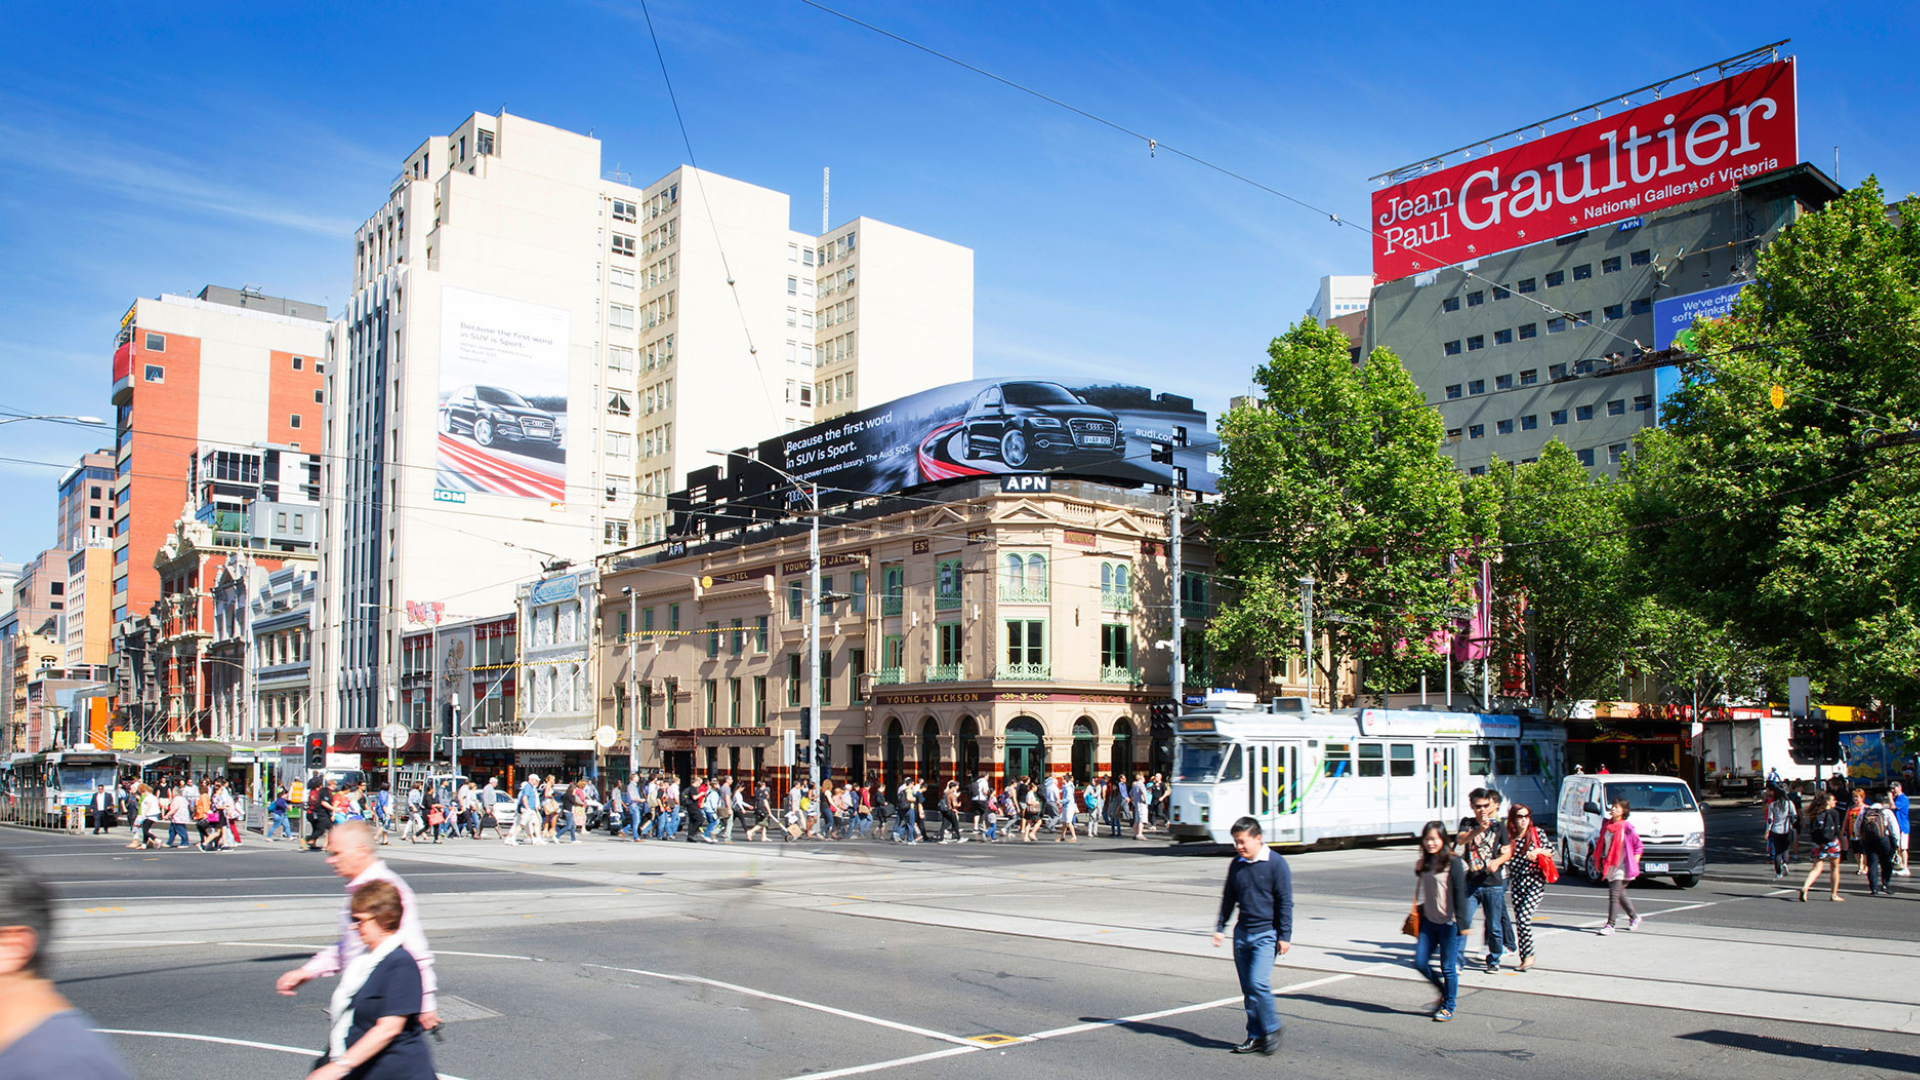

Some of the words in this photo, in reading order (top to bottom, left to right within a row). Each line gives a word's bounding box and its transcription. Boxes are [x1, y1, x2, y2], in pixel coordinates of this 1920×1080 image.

[1457, 97, 1777, 231] Gaultier
[1584, 195, 1641, 221] National
[1644, 180, 1696, 206] Gallery
[1698, 171, 1716, 189] of
[1718, 156, 1778, 184] Victoria
[1379, 186, 1454, 227] Jean
[1621, 220, 1640, 230] APN
[1383, 212, 1452, 257] Paul
[1682, 298, 1713, 311] We've
[1671, 311, 1693, 324] soft
[460, 322, 495, 334] Because
[497, 329, 512, 338] the
[513, 331, 530, 342] first
[532, 335, 553, 346] word
[470, 332, 489, 342] SUV
[490, 336, 498, 344] is
[786, 434, 823, 454] Because
[825, 428, 841, 441] the
[843, 421, 864, 436] first
[866, 410, 893, 429] word
[786, 458, 795, 470] in
[796, 450, 816, 467] SUV
[817, 449, 826, 460] is
[827, 440, 858, 459] Sport.
[803, 467, 823, 480] power
[823, 463, 843, 476] meets
[865, 452, 878, 463] The
[1005, 475, 1048, 490] APN
[1065, 531, 1094, 545] YOUNG
[668, 543, 684, 556] APN
[785, 561, 809, 572] YOUNG
[726, 571, 749, 582] HOTEL
[886, 695, 920, 704] YOUNG
[931, 693, 979, 703] JACKSON
[703, 728, 726, 736] YOUNG
[732, 727, 766, 736] JACKSON
